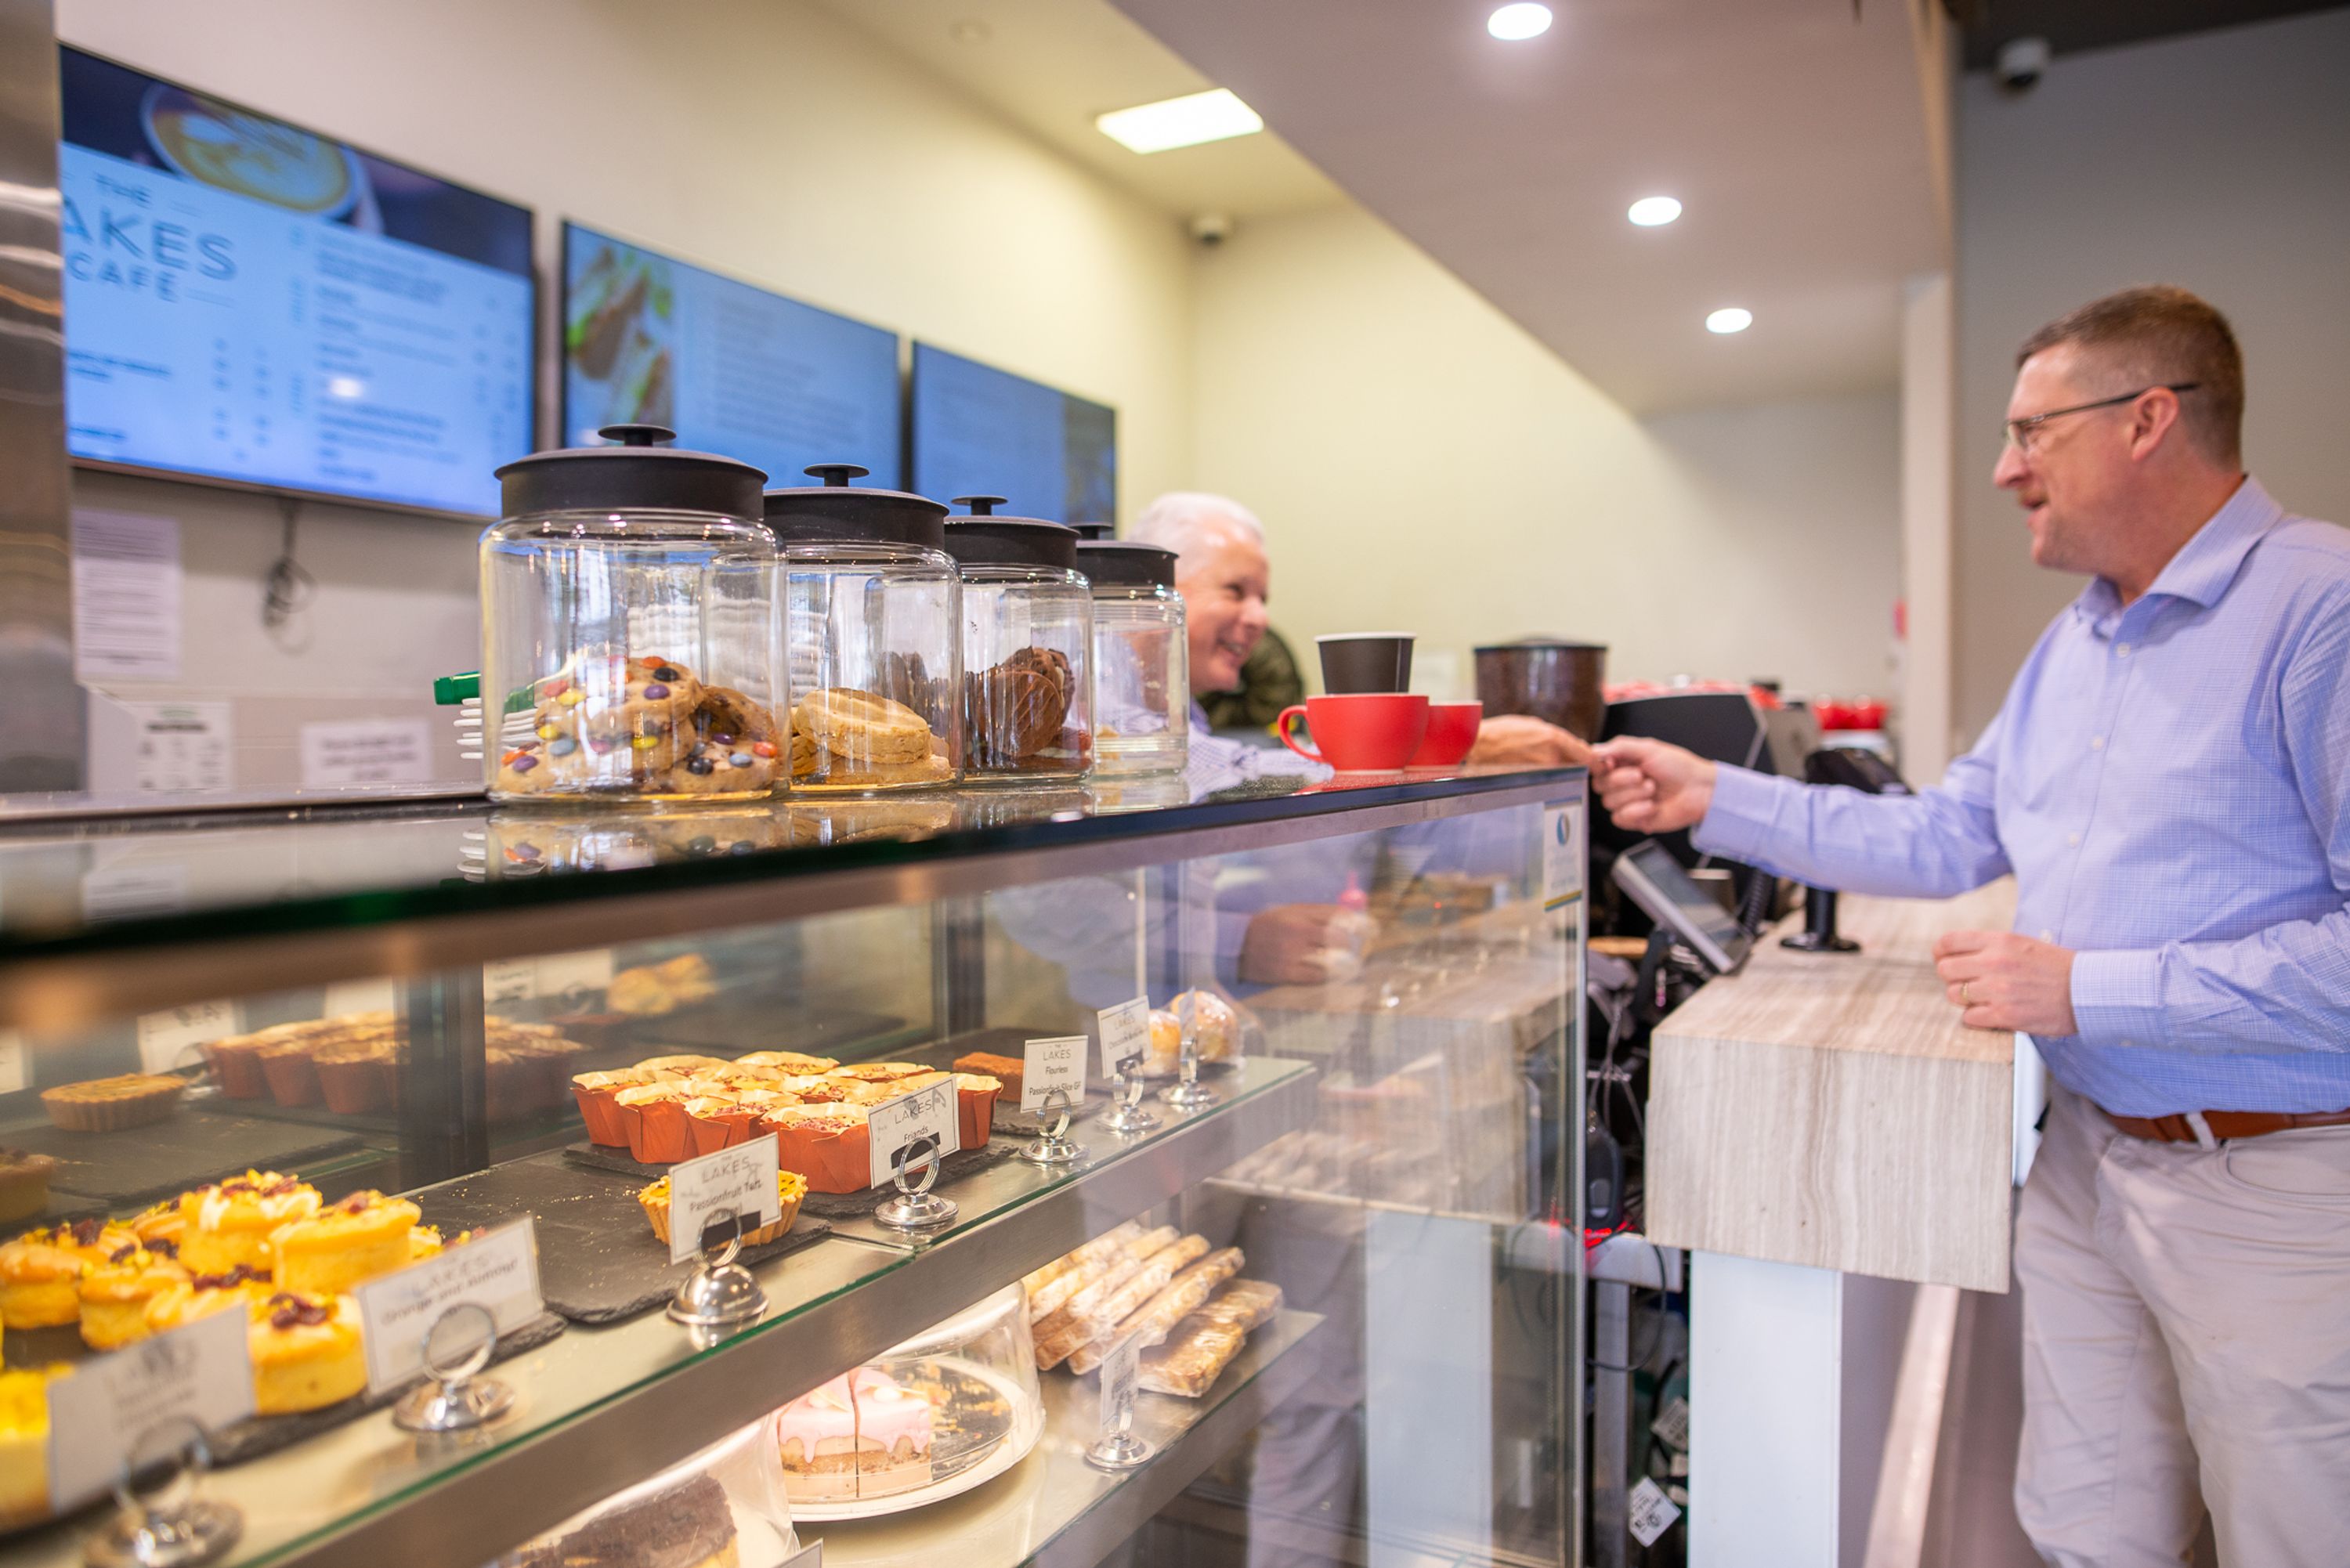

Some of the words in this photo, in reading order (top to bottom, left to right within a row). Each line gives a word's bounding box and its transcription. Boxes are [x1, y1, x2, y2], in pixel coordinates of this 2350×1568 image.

[94, 173, 152, 209] THE
[1043, 1049, 1072, 1060] LAKES
[1045, 1065, 1068, 1075] Flourless
[1061, 1082, 1073, 1091] Slice
[895, 1099, 931, 1124] LAKES
[904, 1125, 928, 1142] Friands
[702, 1156, 750, 1183] LAKES
[689, 1187, 742, 1212] Passionfruit
